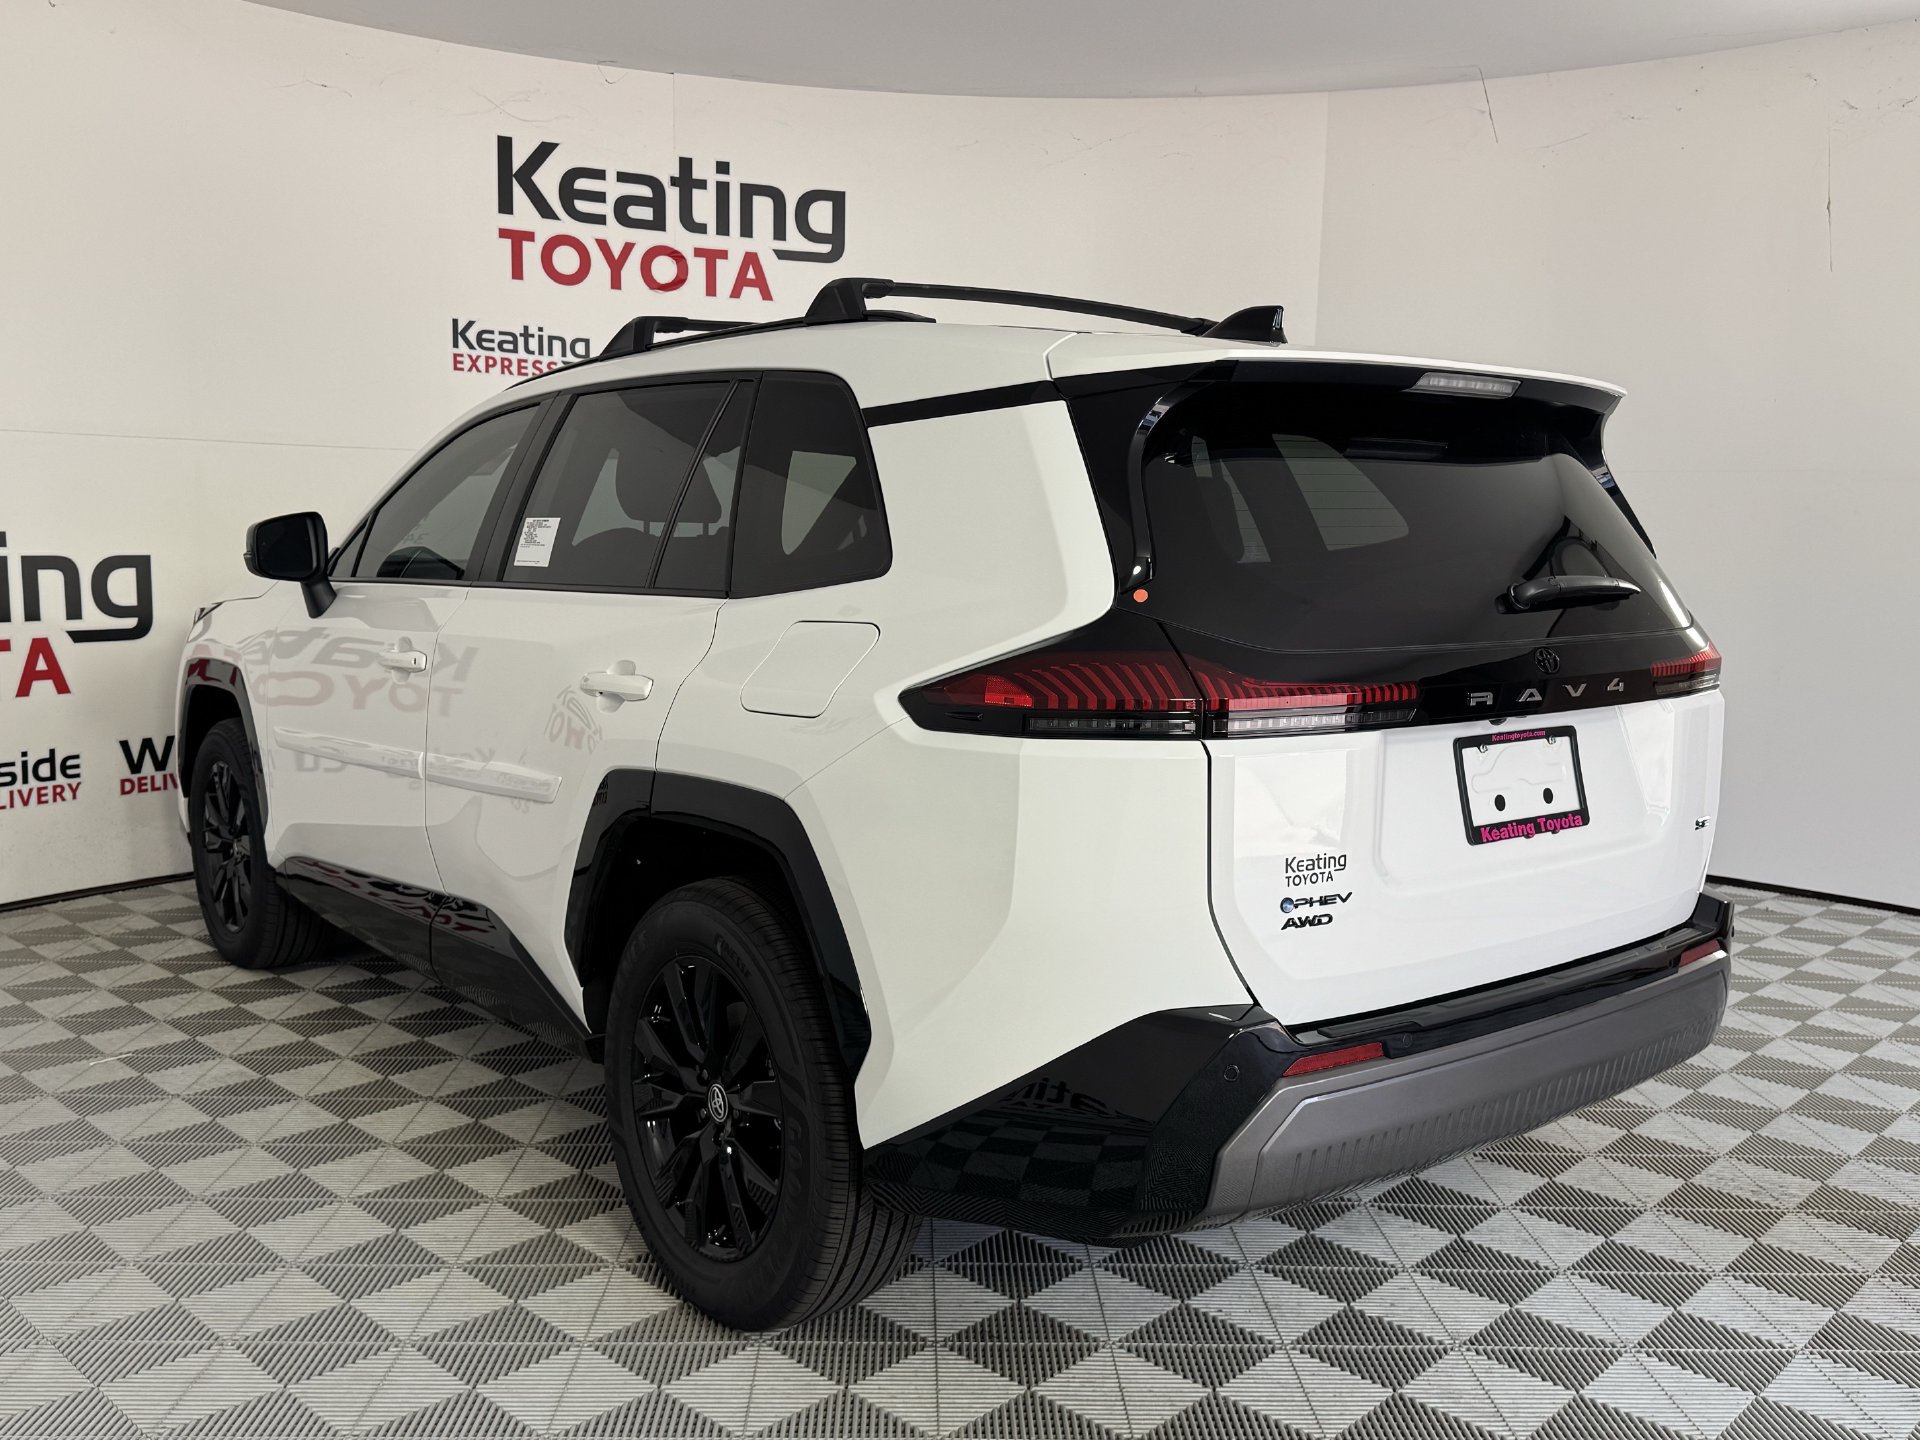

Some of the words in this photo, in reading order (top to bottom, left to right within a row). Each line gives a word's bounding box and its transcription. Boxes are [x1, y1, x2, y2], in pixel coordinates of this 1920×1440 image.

[497, 135, 846, 264] Keating
[498, 228, 774, 301] TOYOTA
[452, 318, 591, 366] Keating
[0, 637, 72, 698] A
[1467, 677, 1625, 706] RAV4
[1480, 822, 1536, 843] Keating
[1537, 813, 1583, 834] Toyota
[1285, 853, 1347, 874] Keating
[1285, 871, 1334, 887] TOYOTA
[1281, 913, 1333, 931] AWD
